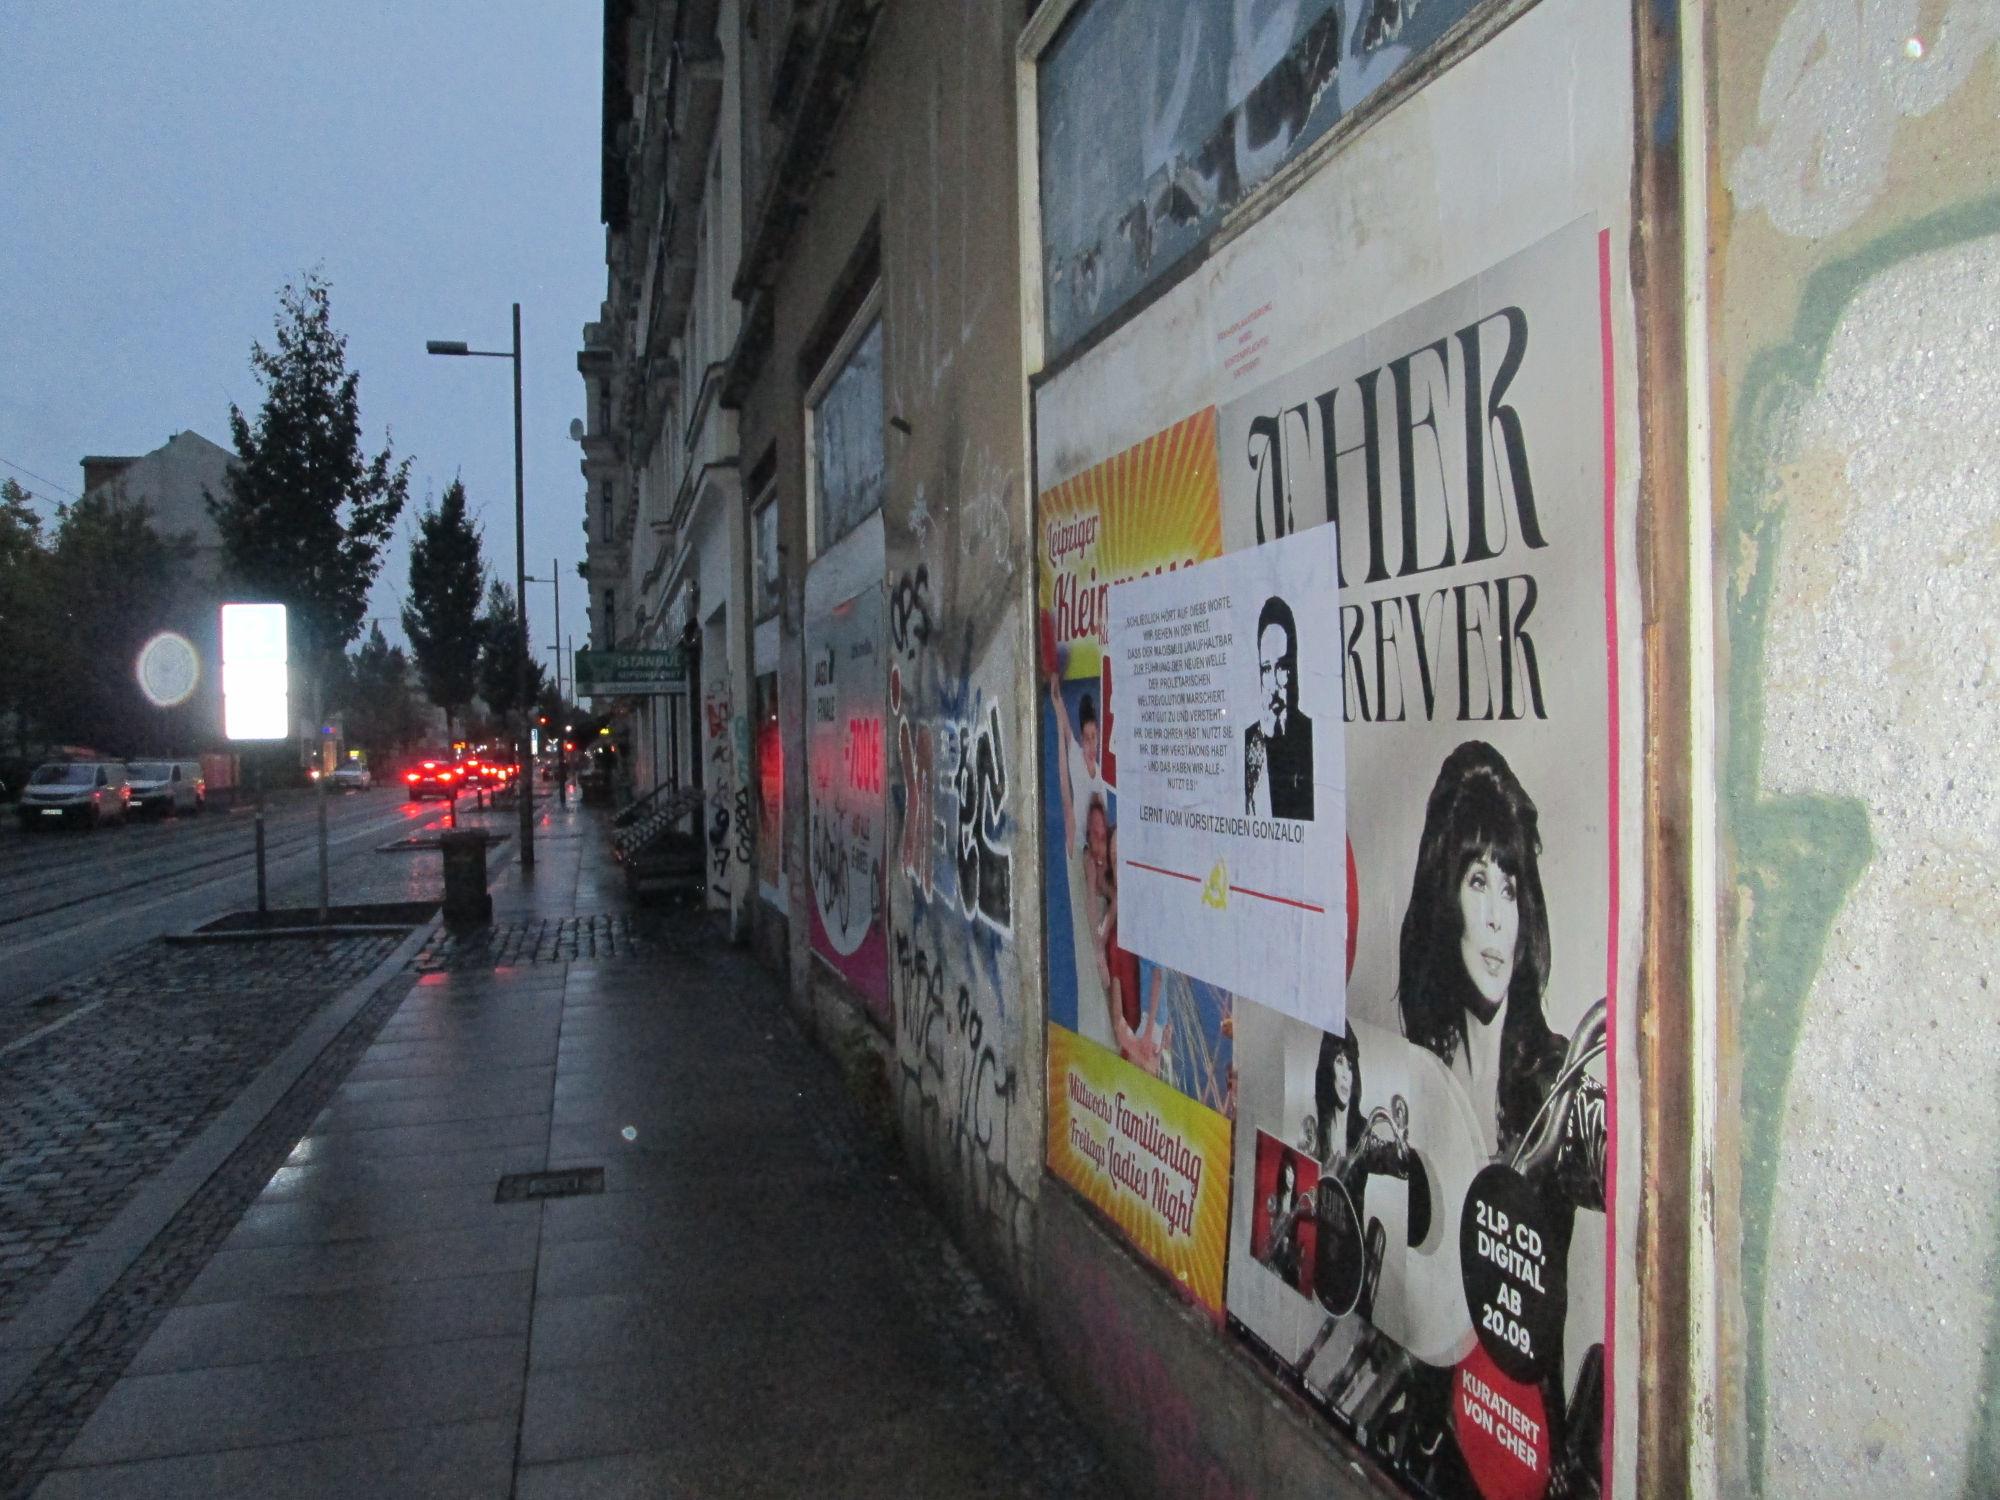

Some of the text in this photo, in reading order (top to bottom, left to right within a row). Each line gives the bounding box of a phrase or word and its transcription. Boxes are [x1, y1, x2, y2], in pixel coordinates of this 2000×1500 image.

[1047, 512, 1099, 568] Leipziger
[1177, 606, 1189, 619] AUF
[1190, 601, 1207, 617] DIESE
[1127, 647, 1142, 660] DASS
[1142, 645, 1154, 658] DER
[1183, 633, 1233, 654] UNAUFHALTBAR
[1143, 629, 1154, 641] WIR
[1155, 627, 1173, 640] SEHEN
[1173, 625, 1180, 637] IN
[1181, 623, 1192, 637] DER
[1339, 573, 1548, 723] REVER
[1134, 663, 1144, 675] ZUR
[1171, 659, 1183, 672] DER
[1184, 656, 1205, 670] NEUEN
[1205, 652, 1227, 668] WELLE
[1148, 673, 1211, 690] DER PROLETARISCHEN
[1138, 694, 1186, 707] WELTREVOLUTION
[1156, 711, 1167, 723] GUT
[1168, 711, 1175, 723] ZU
[1177, 710, 1189, 723] UND
[1144, 727, 1153, 739] DIE
[1153, 728, 1163, 739] IHR
[1163, 727, 1183, 740] OHREN
[1201, 726, 1222, 739] NUTZT
[1150, 743, 1159, 756] DIE
[1211, 744, 1227, 757] HABT
[1147, 760, 1220, 775] UND DAS HABEN WIR ALLE
[1167, 778, 1185, 790] NUTZT
[1139, 804, 1305, 843] LERNT VOM VORSITZENDEN GONZALO!
[1068, 1072, 1202, 1200] Mittwochs Familientag
[1070, 1117, 1194, 1237] Freitags Ladies Night
[1515, 1223, 1546, 1265] CD,
[1477, 1230, 1545, 1294] DIGITAL
[1496, 1282, 1522, 1316] AB
[1482, 1303, 1534, 1360] 20.09.
[1462, 1369, 1540, 1445] KURATIERT
[1463, 1395, 1538, 1472] VON CHER
